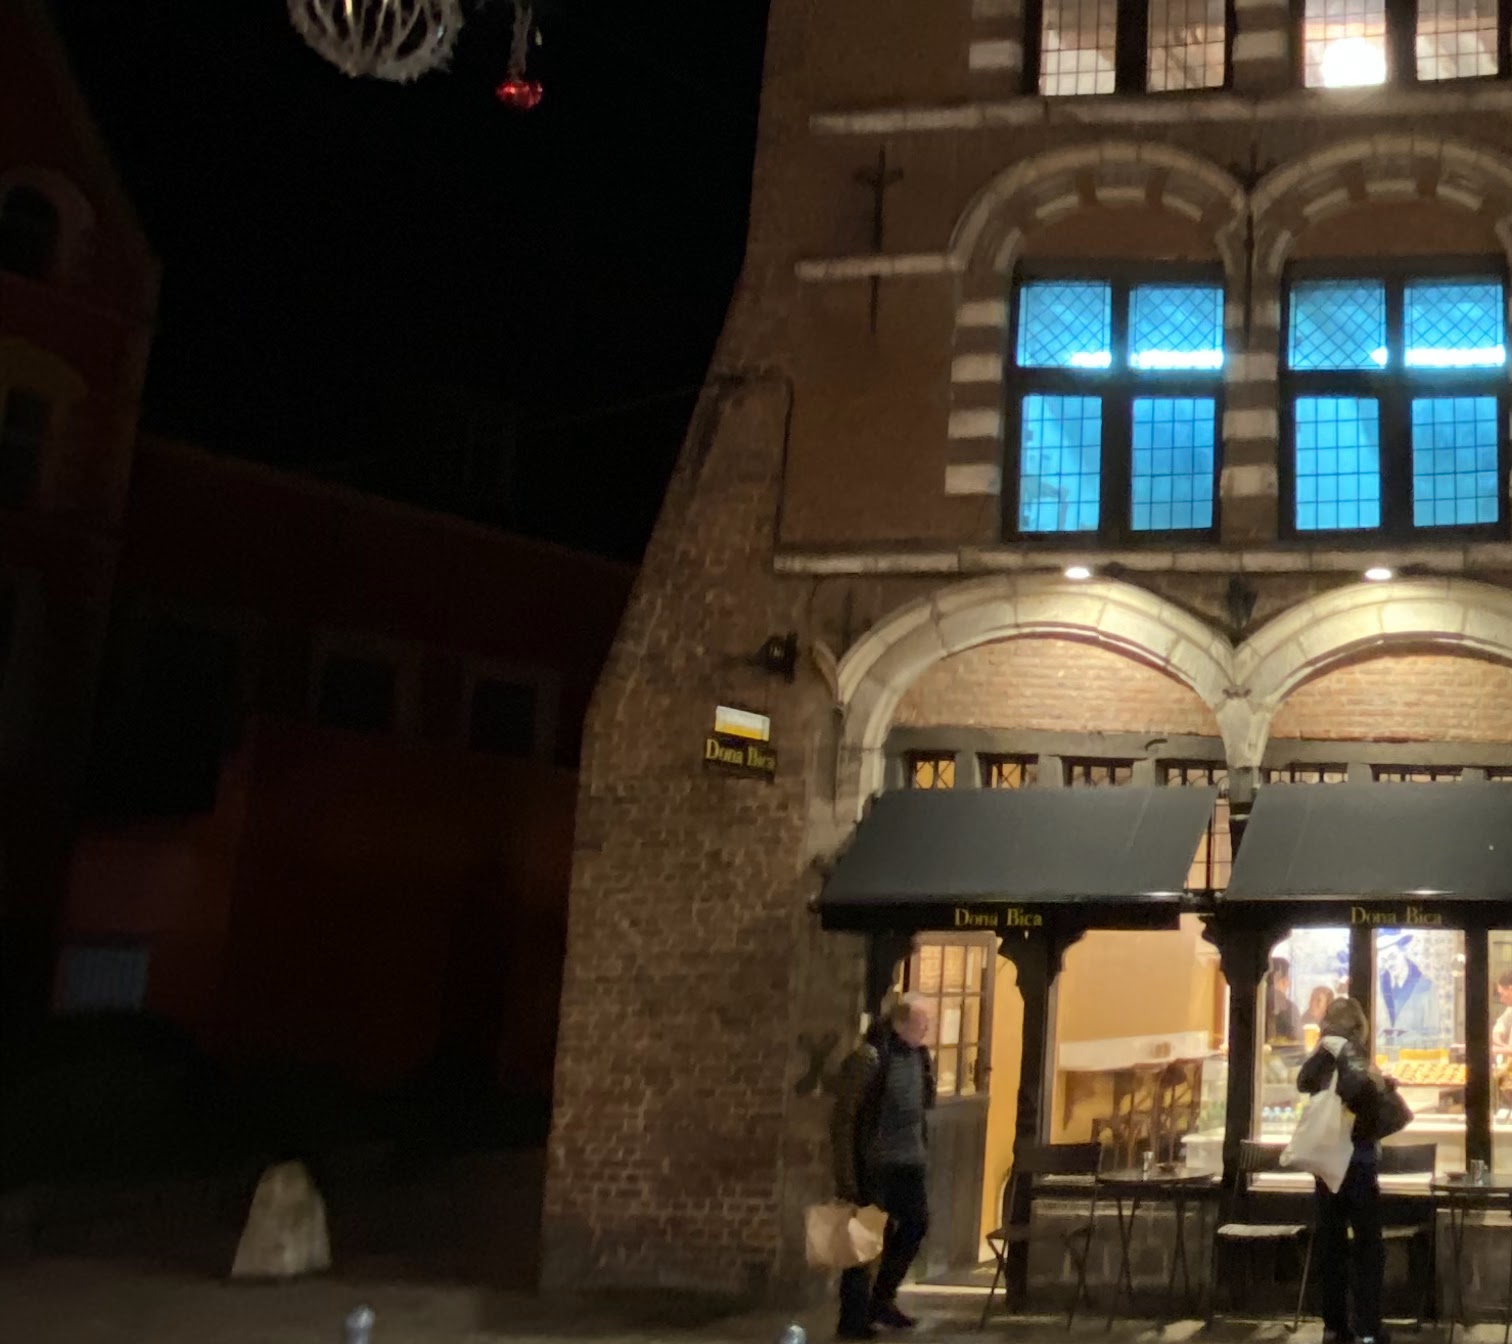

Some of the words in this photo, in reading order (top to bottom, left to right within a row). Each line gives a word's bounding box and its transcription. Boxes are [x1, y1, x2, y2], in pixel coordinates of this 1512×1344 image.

[706, 739, 743, 764] Dona
[955, 908, 998, 926] Dona
[1007, 907, 1042, 926] Bica
[1351, 906, 1397, 924] Dona
[1407, 906, 1442, 924] Bica
